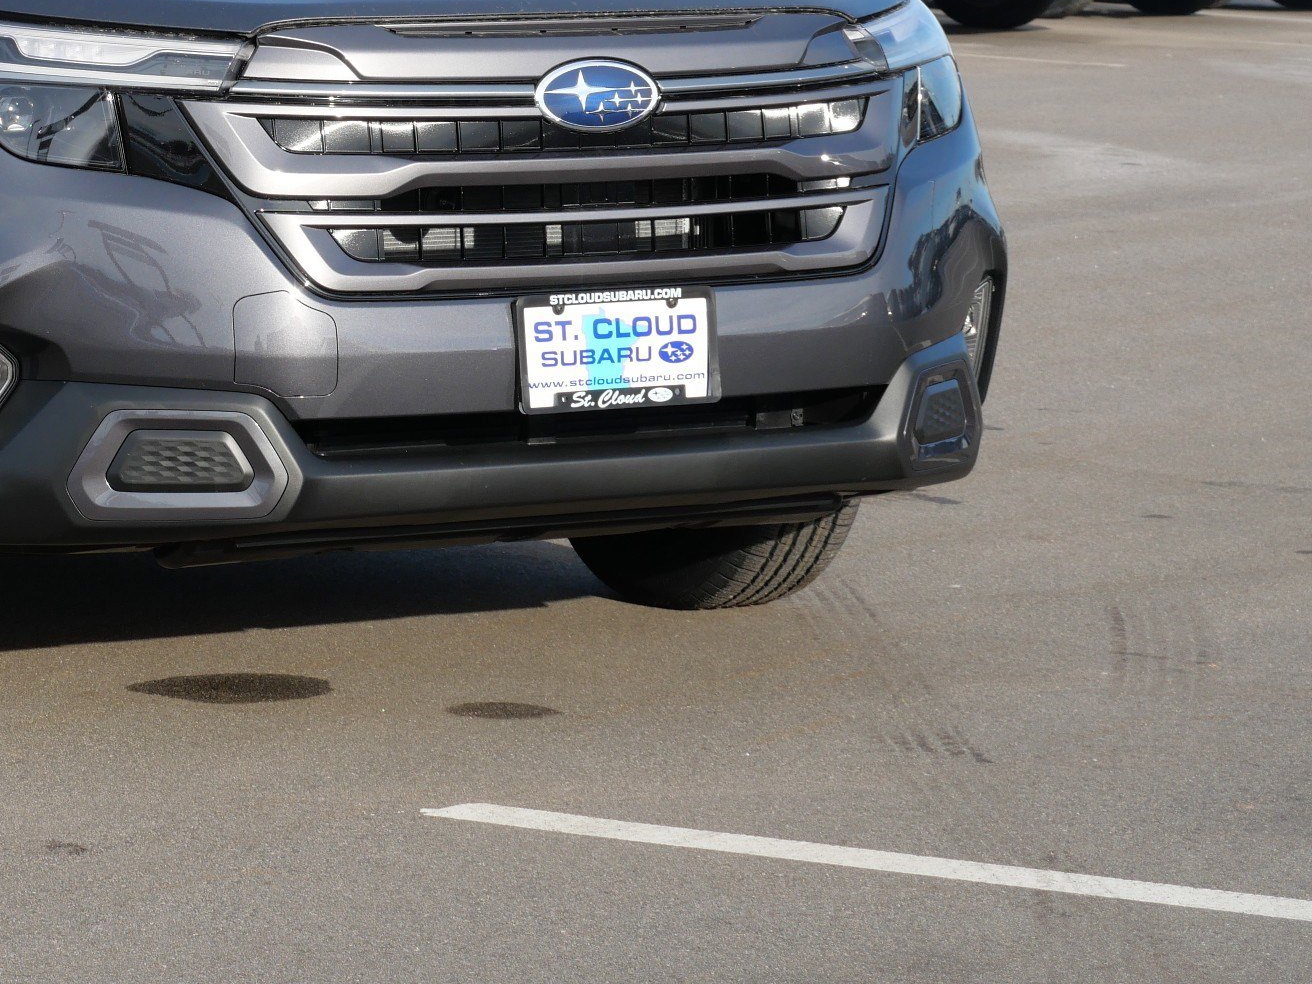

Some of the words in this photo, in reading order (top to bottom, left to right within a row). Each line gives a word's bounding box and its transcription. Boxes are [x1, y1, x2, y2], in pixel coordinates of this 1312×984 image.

[549, 288, 682, 305] STCLOUDSUBARU.COM
[533, 320, 579, 342] ST.
[592, 314, 697, 339] CLOUD
[541, 346, 652, 367] SUBARU
[528, 371, 705, 389] www.stcloudsubaru.com
[570, 391, 595, 408] St.
[597, 388, 646, 408] Cloud
